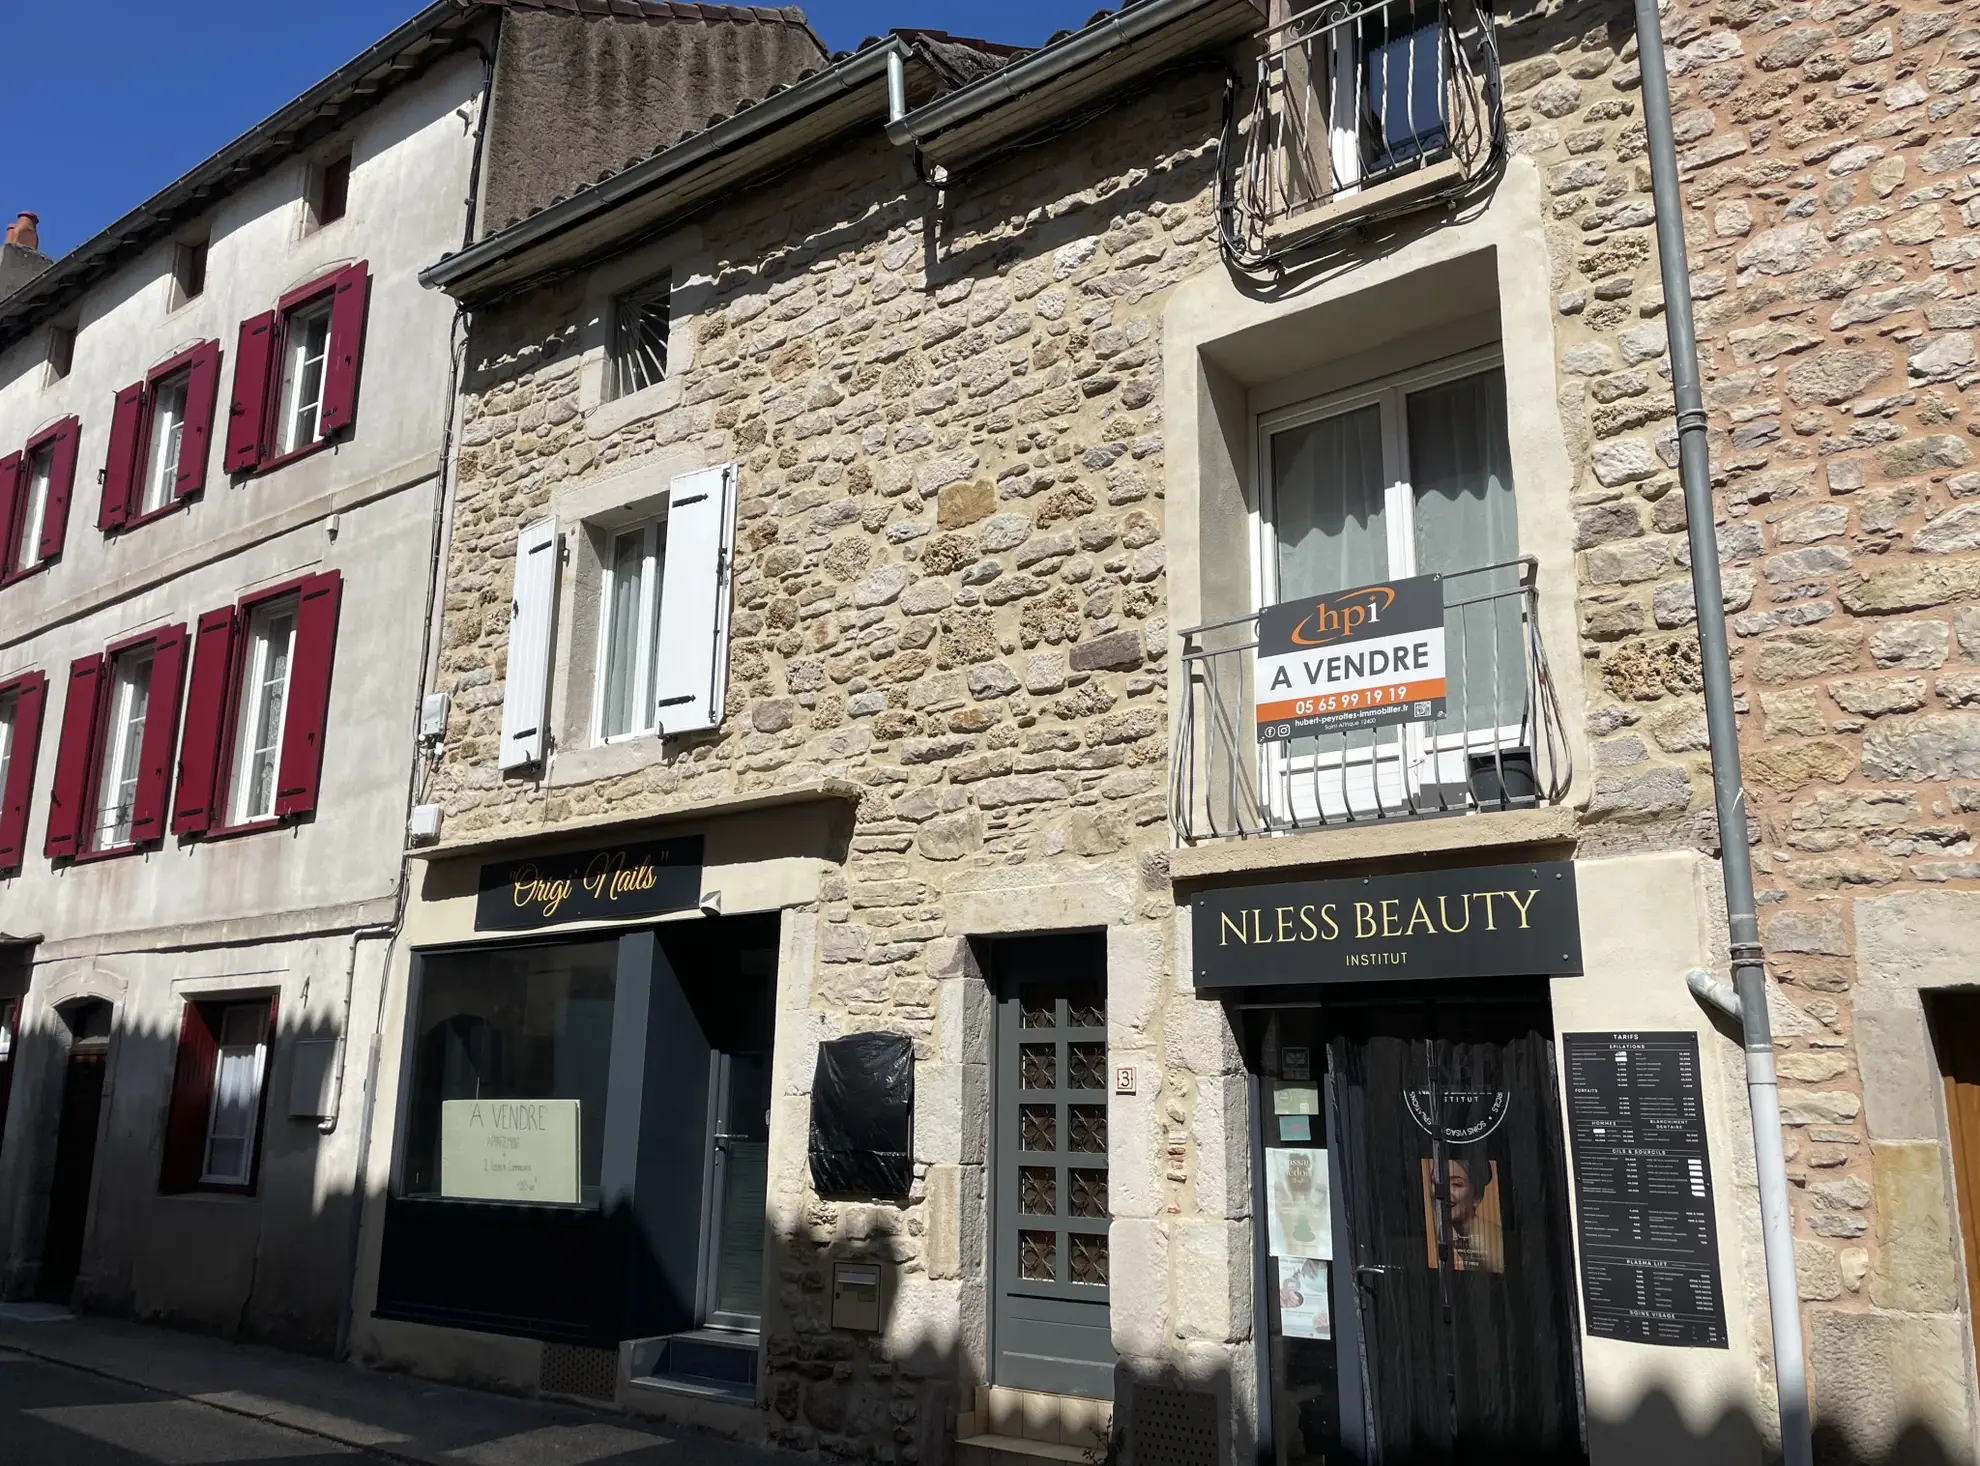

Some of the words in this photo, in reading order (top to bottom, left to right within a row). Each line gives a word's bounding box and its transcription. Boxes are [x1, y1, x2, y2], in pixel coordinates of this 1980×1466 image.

[1317, 594, 1380, 636] hpi
[1270, 665, 1293, 691] A
[1303, 641, 1429, 685] VENDRE
[1295, 701, 1314, 715] 05
[1318, 697, 1337, 711] 65
[1341, 693, 1360, 708] 99
[1365, 689, 1383, 705] 19
[1389, 685, 1408, 700] 19
[1294, 704, 1409, 727] hubert-peyrottes-immobilier.fr
[1324, 722, 1338, 731] Saint
[1360, 717, 1377, 726] 12400
[1218, 903, 1340, 947] NLESS
[1353, 888, 1541, 940] BEAUTY
[1345, 951, 1408, 967] INSTITUT
[1120, 1070, 1130, 1087] 3
[469, 1103, 484, 1128] A
[491, 1103, 548, 1131] VENDRE
[1444, 1128, 1468, 1138] VISAG
